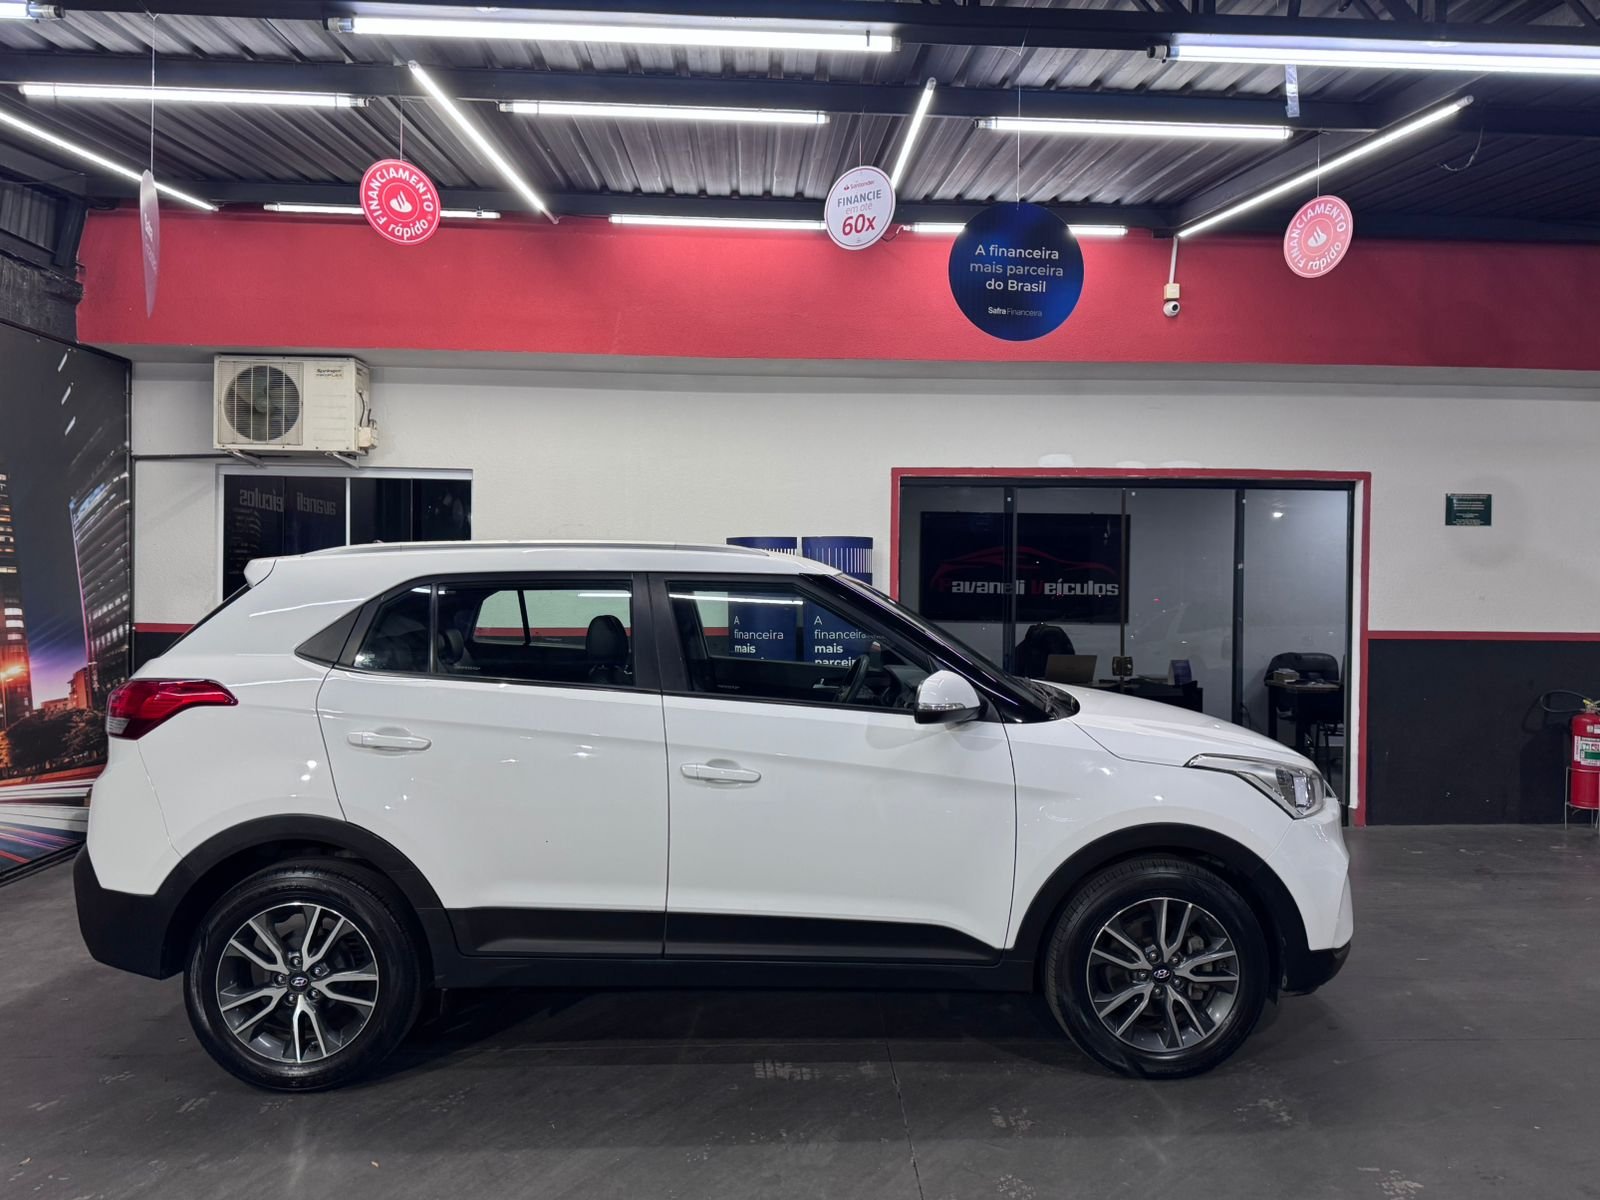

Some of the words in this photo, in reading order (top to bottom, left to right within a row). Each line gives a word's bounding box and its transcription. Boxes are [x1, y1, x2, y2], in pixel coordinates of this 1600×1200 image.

[368, 167, 434, 225] FINANCIAMENTO
[837, 189, 882, 208] FINANCIE
[388, 219, 428, 240] rápido
[842, 213, 876, 236] 60x
[1290, 203, 1346, 268] FINANCIAMENTO
[975, 244, 986, 256] A
[989, 244, 1059, 260] financeira
[1307, 242, 1342, 271] rápido
[970, 261, 1003, 273] mais
[1007, 264, 1064, 277] parceira
[986, 278, 1003, 290] do
[1008, 280, 1046, 293] Brasil
[733, 615, 740, 625] A
[814, 615, 823, 625] A
[734, 629, 784, 640] financeira
[734, 643, 756, 654] mais
[814, 643, 843, 654] mais
